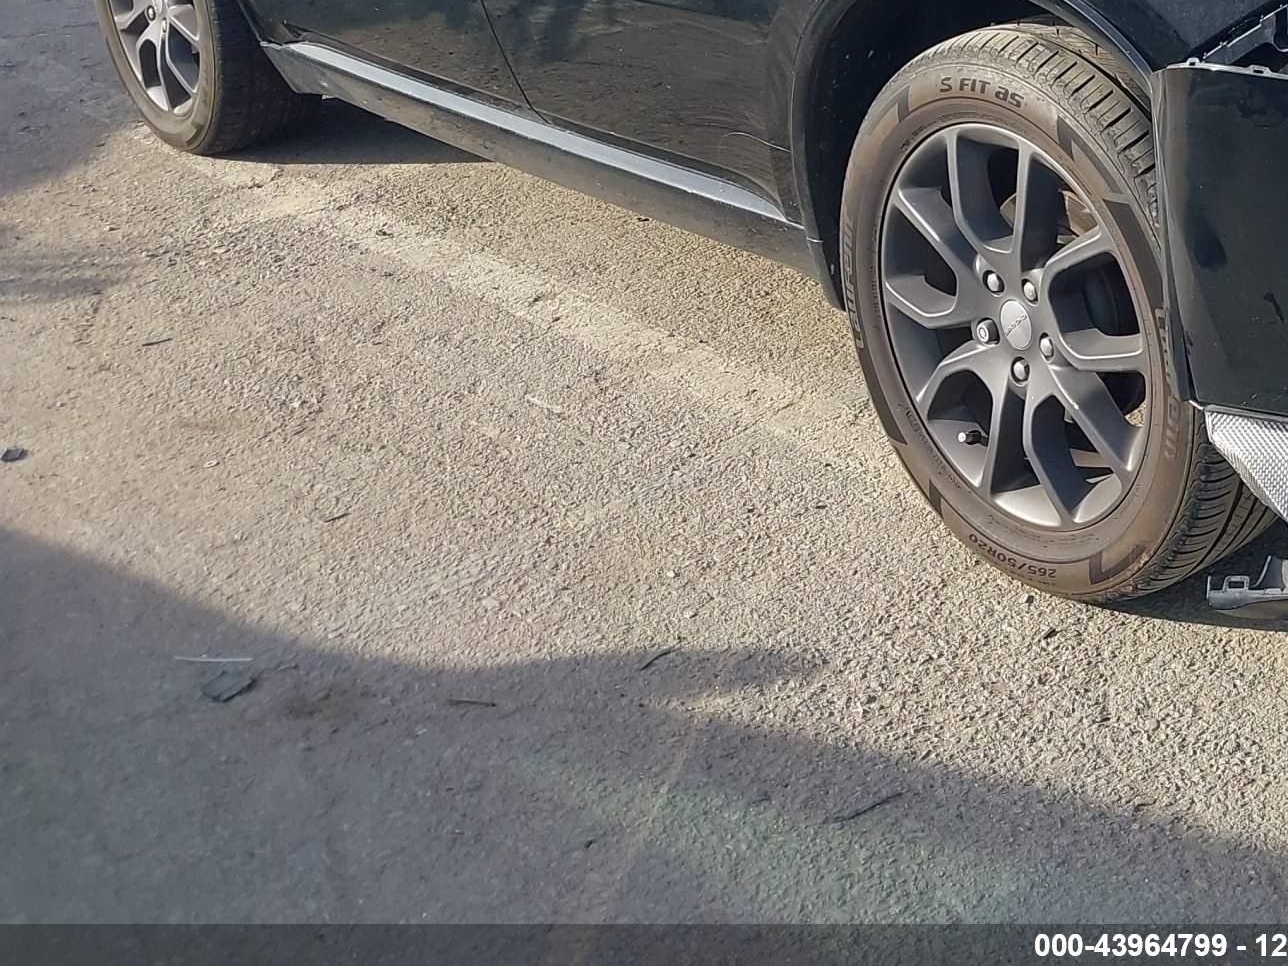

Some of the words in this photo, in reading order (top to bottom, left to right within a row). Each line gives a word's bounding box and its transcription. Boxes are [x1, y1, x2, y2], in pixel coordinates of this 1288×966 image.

[939, 77, 953, 93] S
[959, 78, 992, 94] FIT
[968, 533, 1057, 579] 265/50R20
